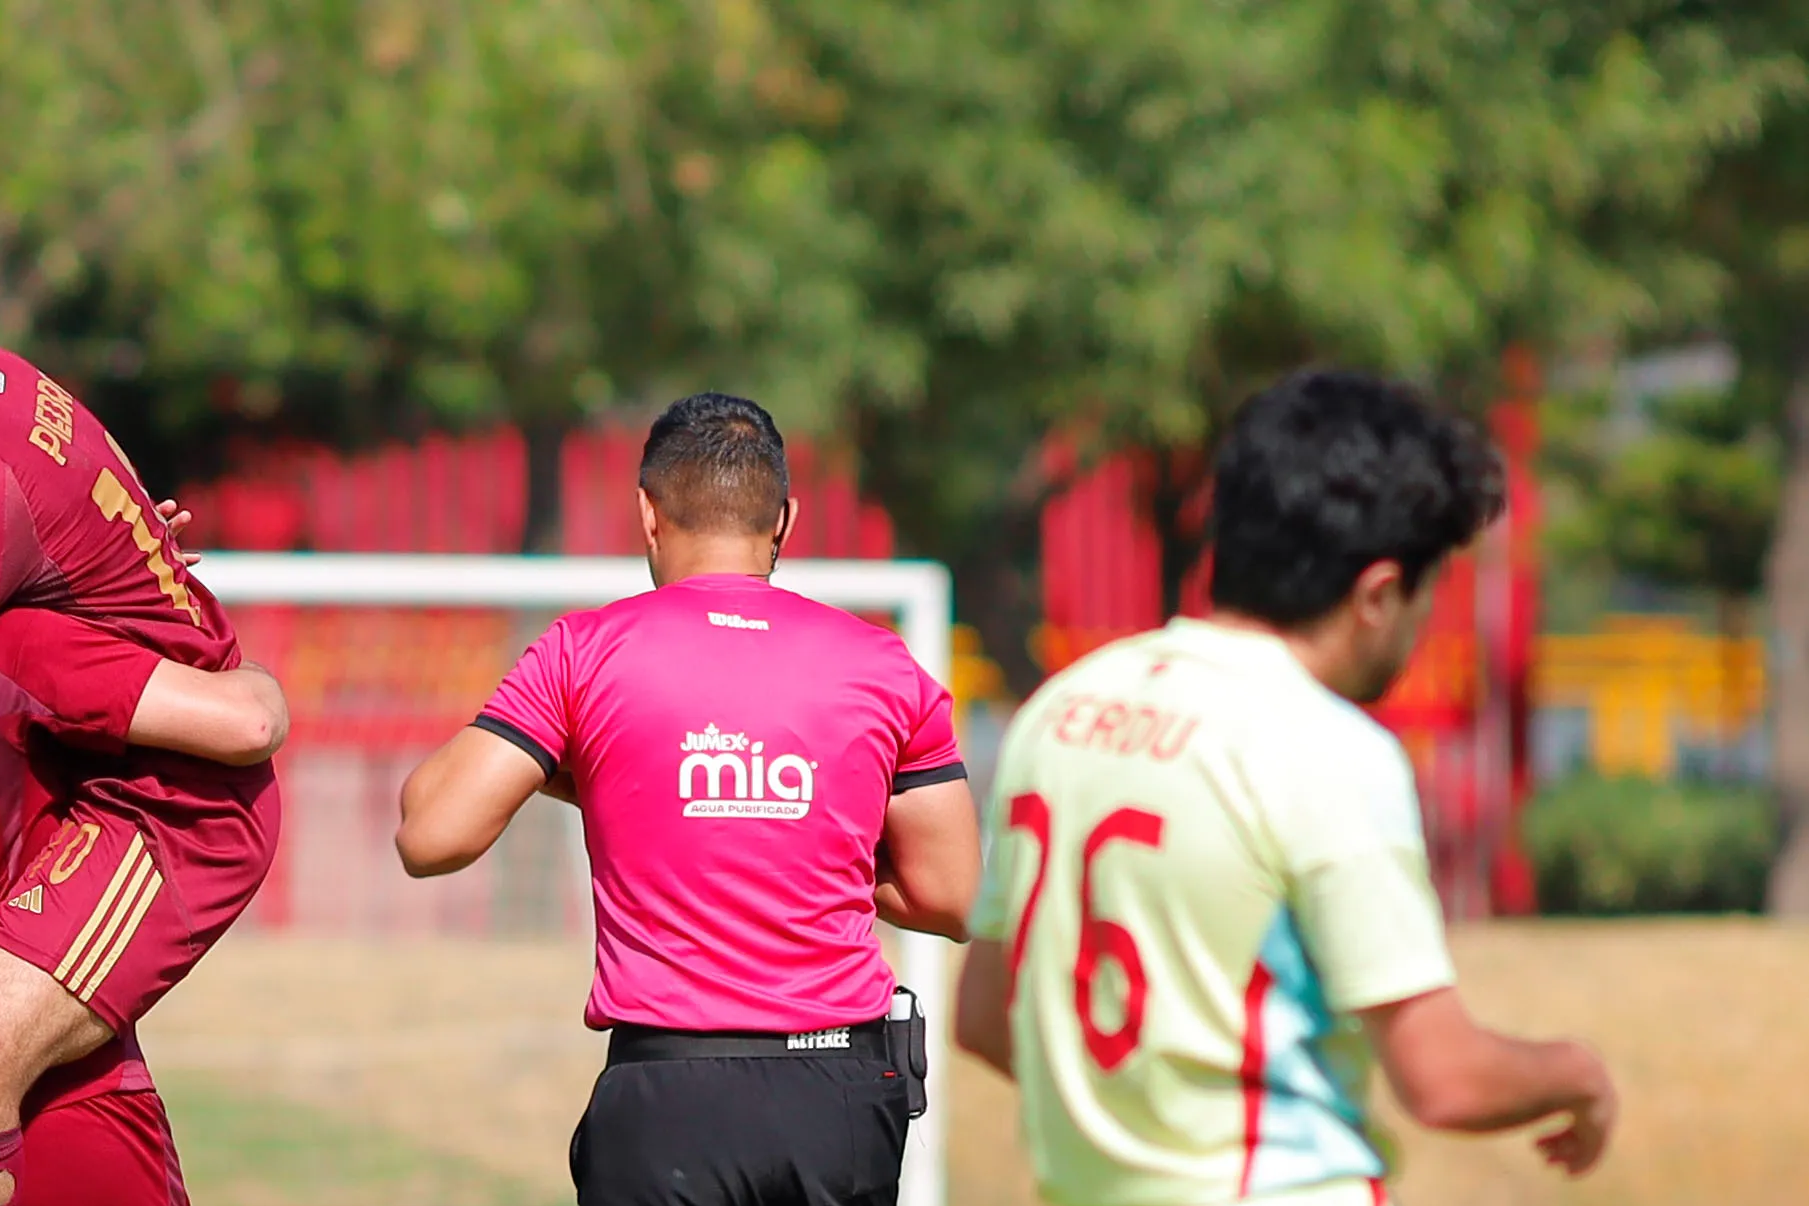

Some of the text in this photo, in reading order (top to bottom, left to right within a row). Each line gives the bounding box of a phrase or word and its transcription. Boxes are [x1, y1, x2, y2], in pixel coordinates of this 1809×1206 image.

[29, 369, 73, 466] PIEDR
[708, 612, 769, 631] Wilson
[680, 731, 746, 752] JUMEX
[691, 804, 800, 815] AGUA PURIFICADA
